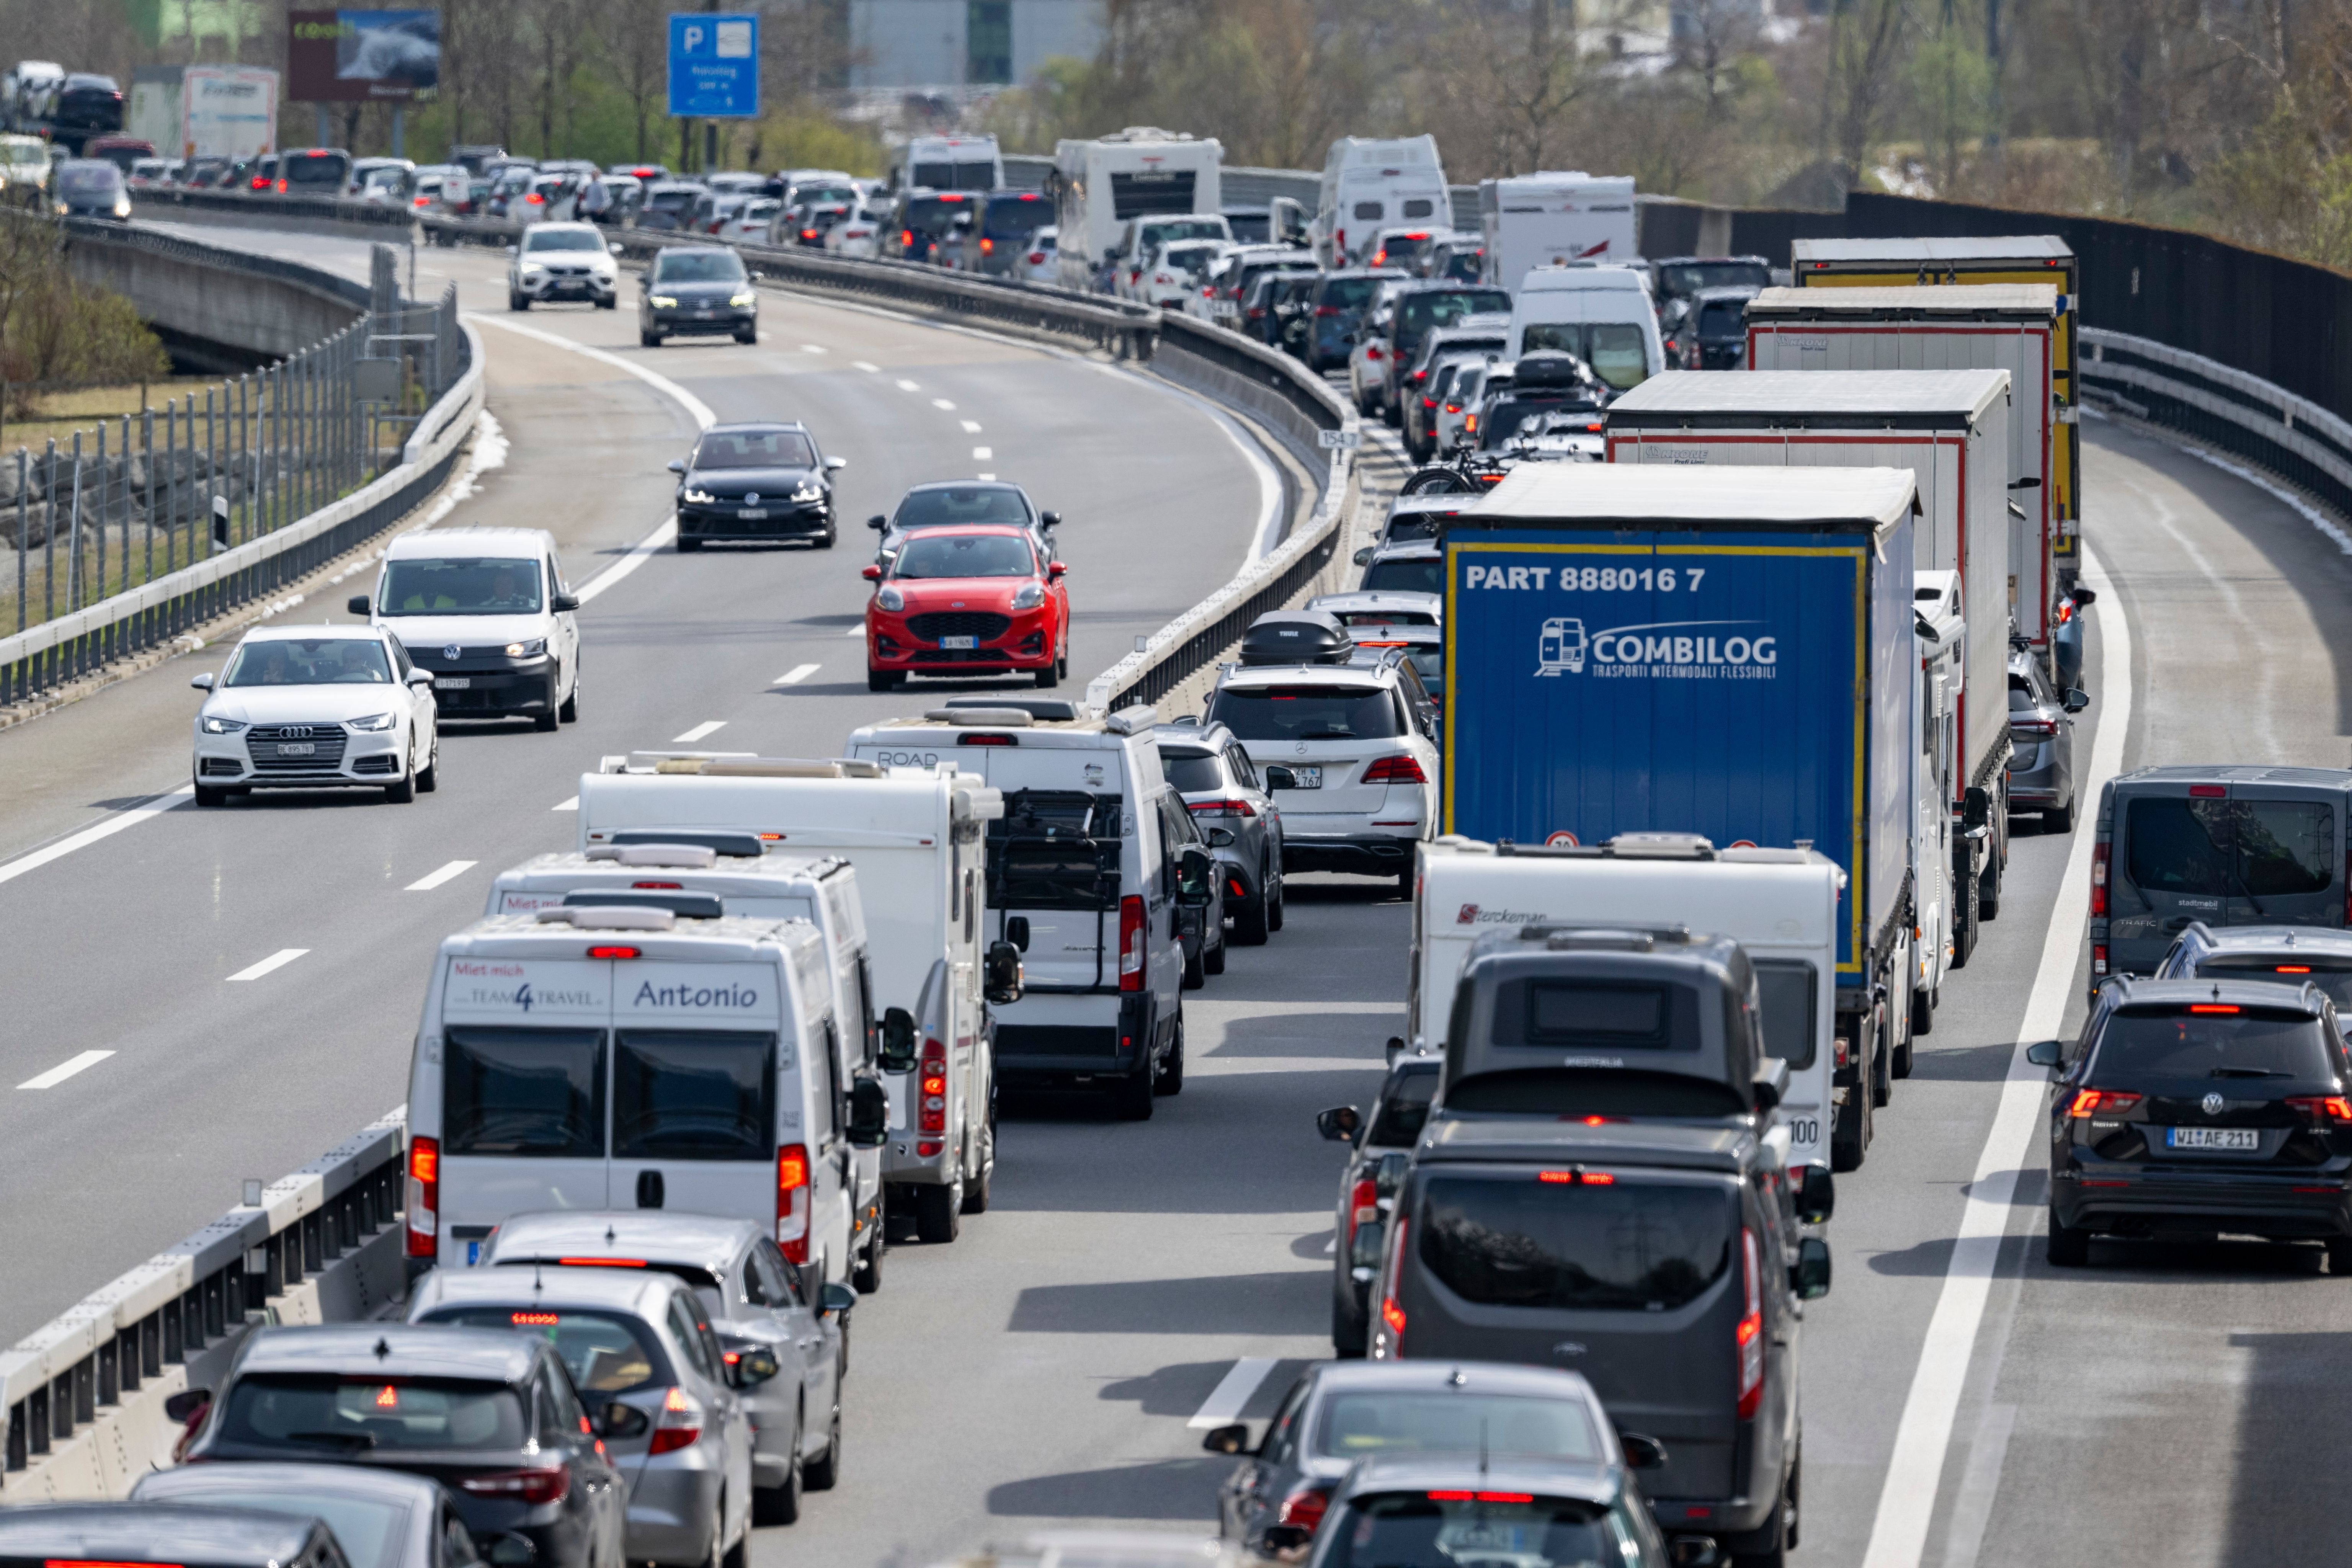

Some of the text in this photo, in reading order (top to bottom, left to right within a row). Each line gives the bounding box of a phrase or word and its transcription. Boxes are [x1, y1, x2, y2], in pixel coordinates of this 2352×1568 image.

[684, 25, 704, 53] P
[1661, 449, 1708, 459] KRONE
[1467, 566, 1705, 591] PART 888016 7
[1594, 636, 1777, 664] COMBILOG
[1592, 665, 1648, 678] TRASPORTI
[1721, 665, 1776, 679] FLESSIBILI
[878, 752, 939, 766] ROAD
[508, 897, 538, 910] Miet
[1456, 904, 1547, 924] Sterckeman
[455, 963, 524, 976] Miet mich
[633, 980, 757, 1008] Antonio
[1789, 1120, 1818, 1143] 100
[2177, 1131, 2194, 1145] WI
[2226, 1132, 2254, 1146] 211
